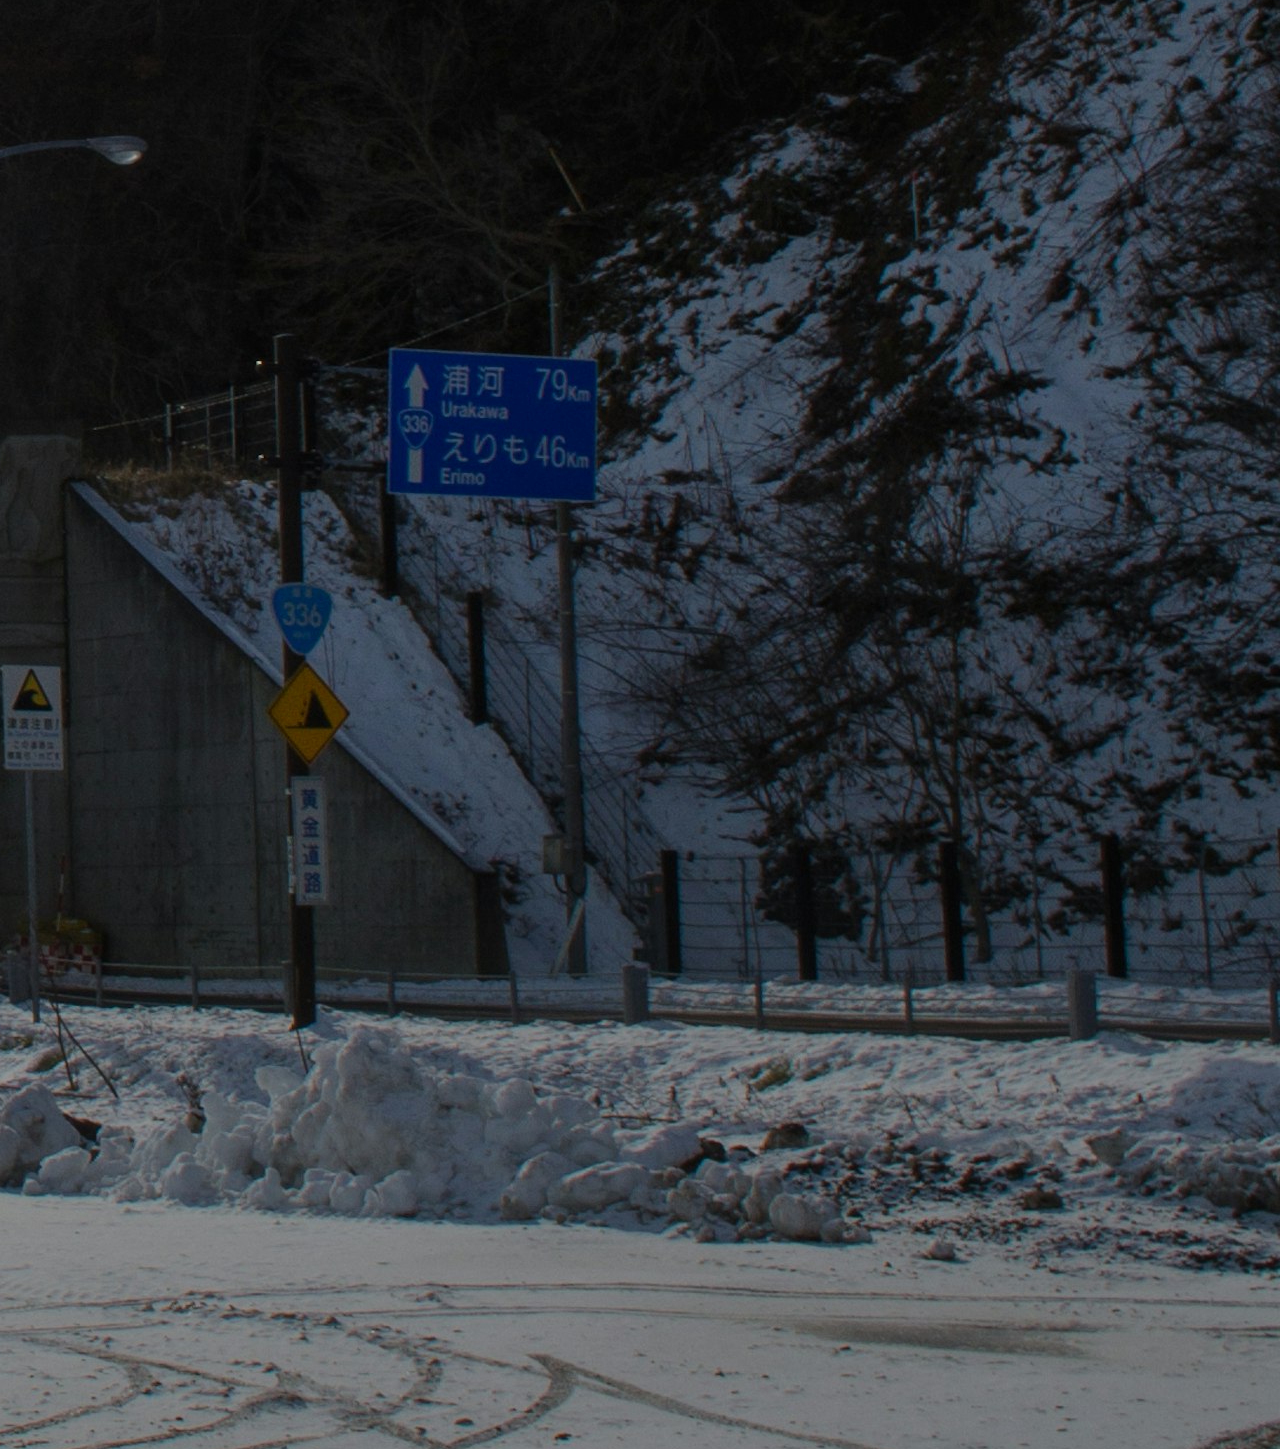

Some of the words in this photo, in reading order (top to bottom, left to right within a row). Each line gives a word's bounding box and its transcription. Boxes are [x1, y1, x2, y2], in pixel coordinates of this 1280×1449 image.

[442, 364, 505, 398] 浦河
[441, 400, 509, 420] Urakawa
[402, 414, 429, 433] 336
[442, 432, 528, 465] えりも
[440, 467, 485, 486] Erimo
[282, 602, 322, 628] 336
[301, 788, 321, 894] 黄金道路
